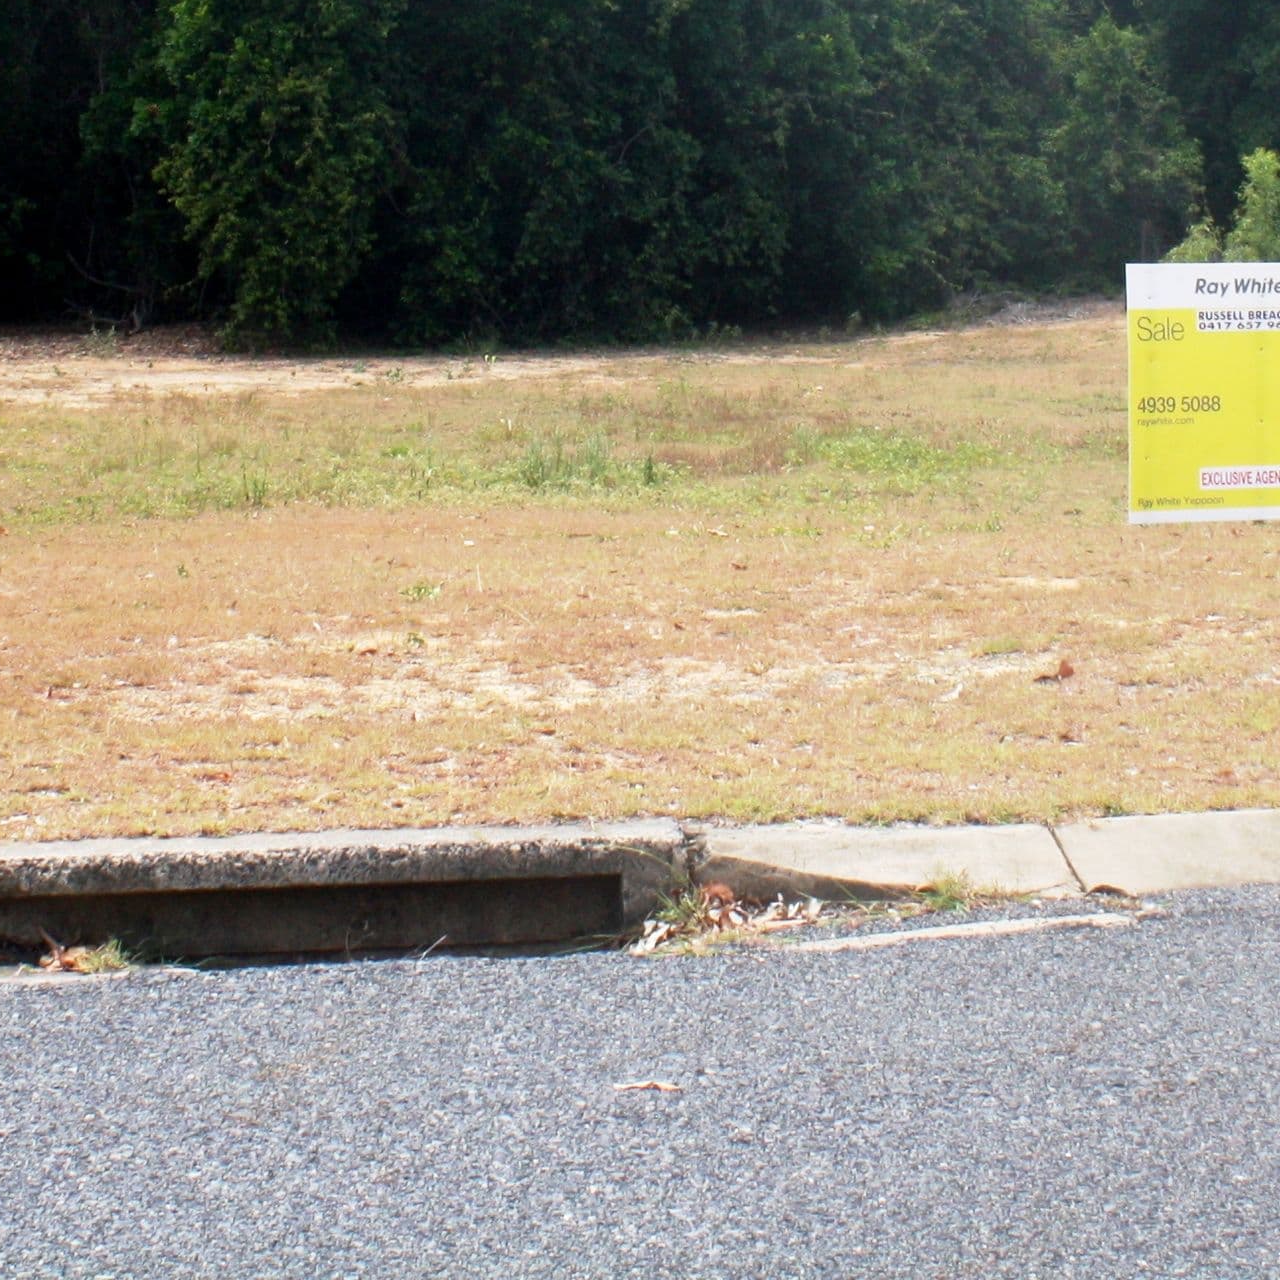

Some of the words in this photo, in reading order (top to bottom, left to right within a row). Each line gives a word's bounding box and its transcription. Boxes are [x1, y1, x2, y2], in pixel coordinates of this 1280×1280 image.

[1195, 278, 1230, 296] Ray
[1198, 311, 1244, 321] RUSSELL
[1137, 316, 1184, 342] Sale
[1198, 321, 1231, 330] 0417
[1237, 321, 1261, 330] 657
[1137, 396, 1176, 413] 4939
[1181, 395, 1221, 412] 5088
[1201, 472, 1253, 486] EXCLUSIVE
[1156, 497, 1181, 506] White
